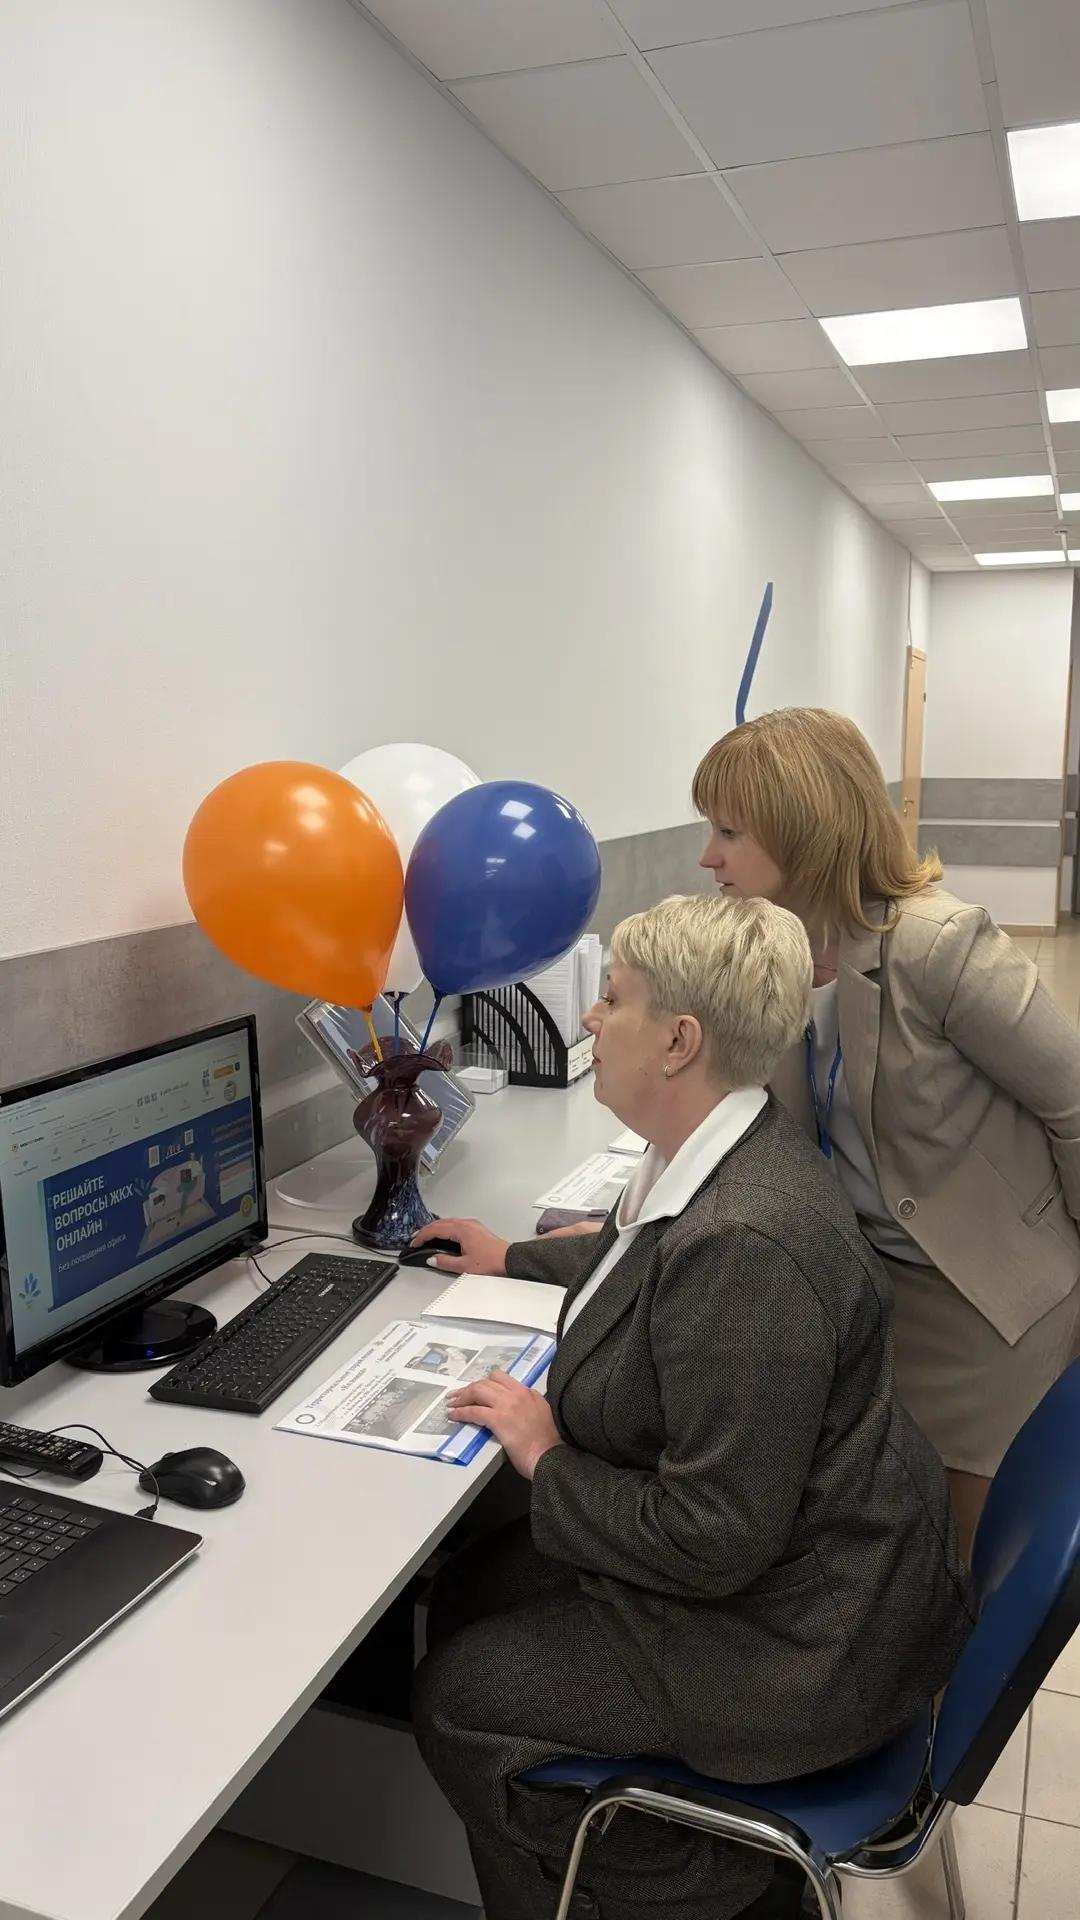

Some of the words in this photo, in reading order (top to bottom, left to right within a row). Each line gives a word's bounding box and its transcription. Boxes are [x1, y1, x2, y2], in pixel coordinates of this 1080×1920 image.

[53, 1175, 105, 1209] РЕШАЙТЕ
[55, 1195, 108, 1231] ВОПРОСЫ
[110, 1183, 134, 1206] ЖКХ
[56, 1218, 103, 1252] ОНЛАЙН
